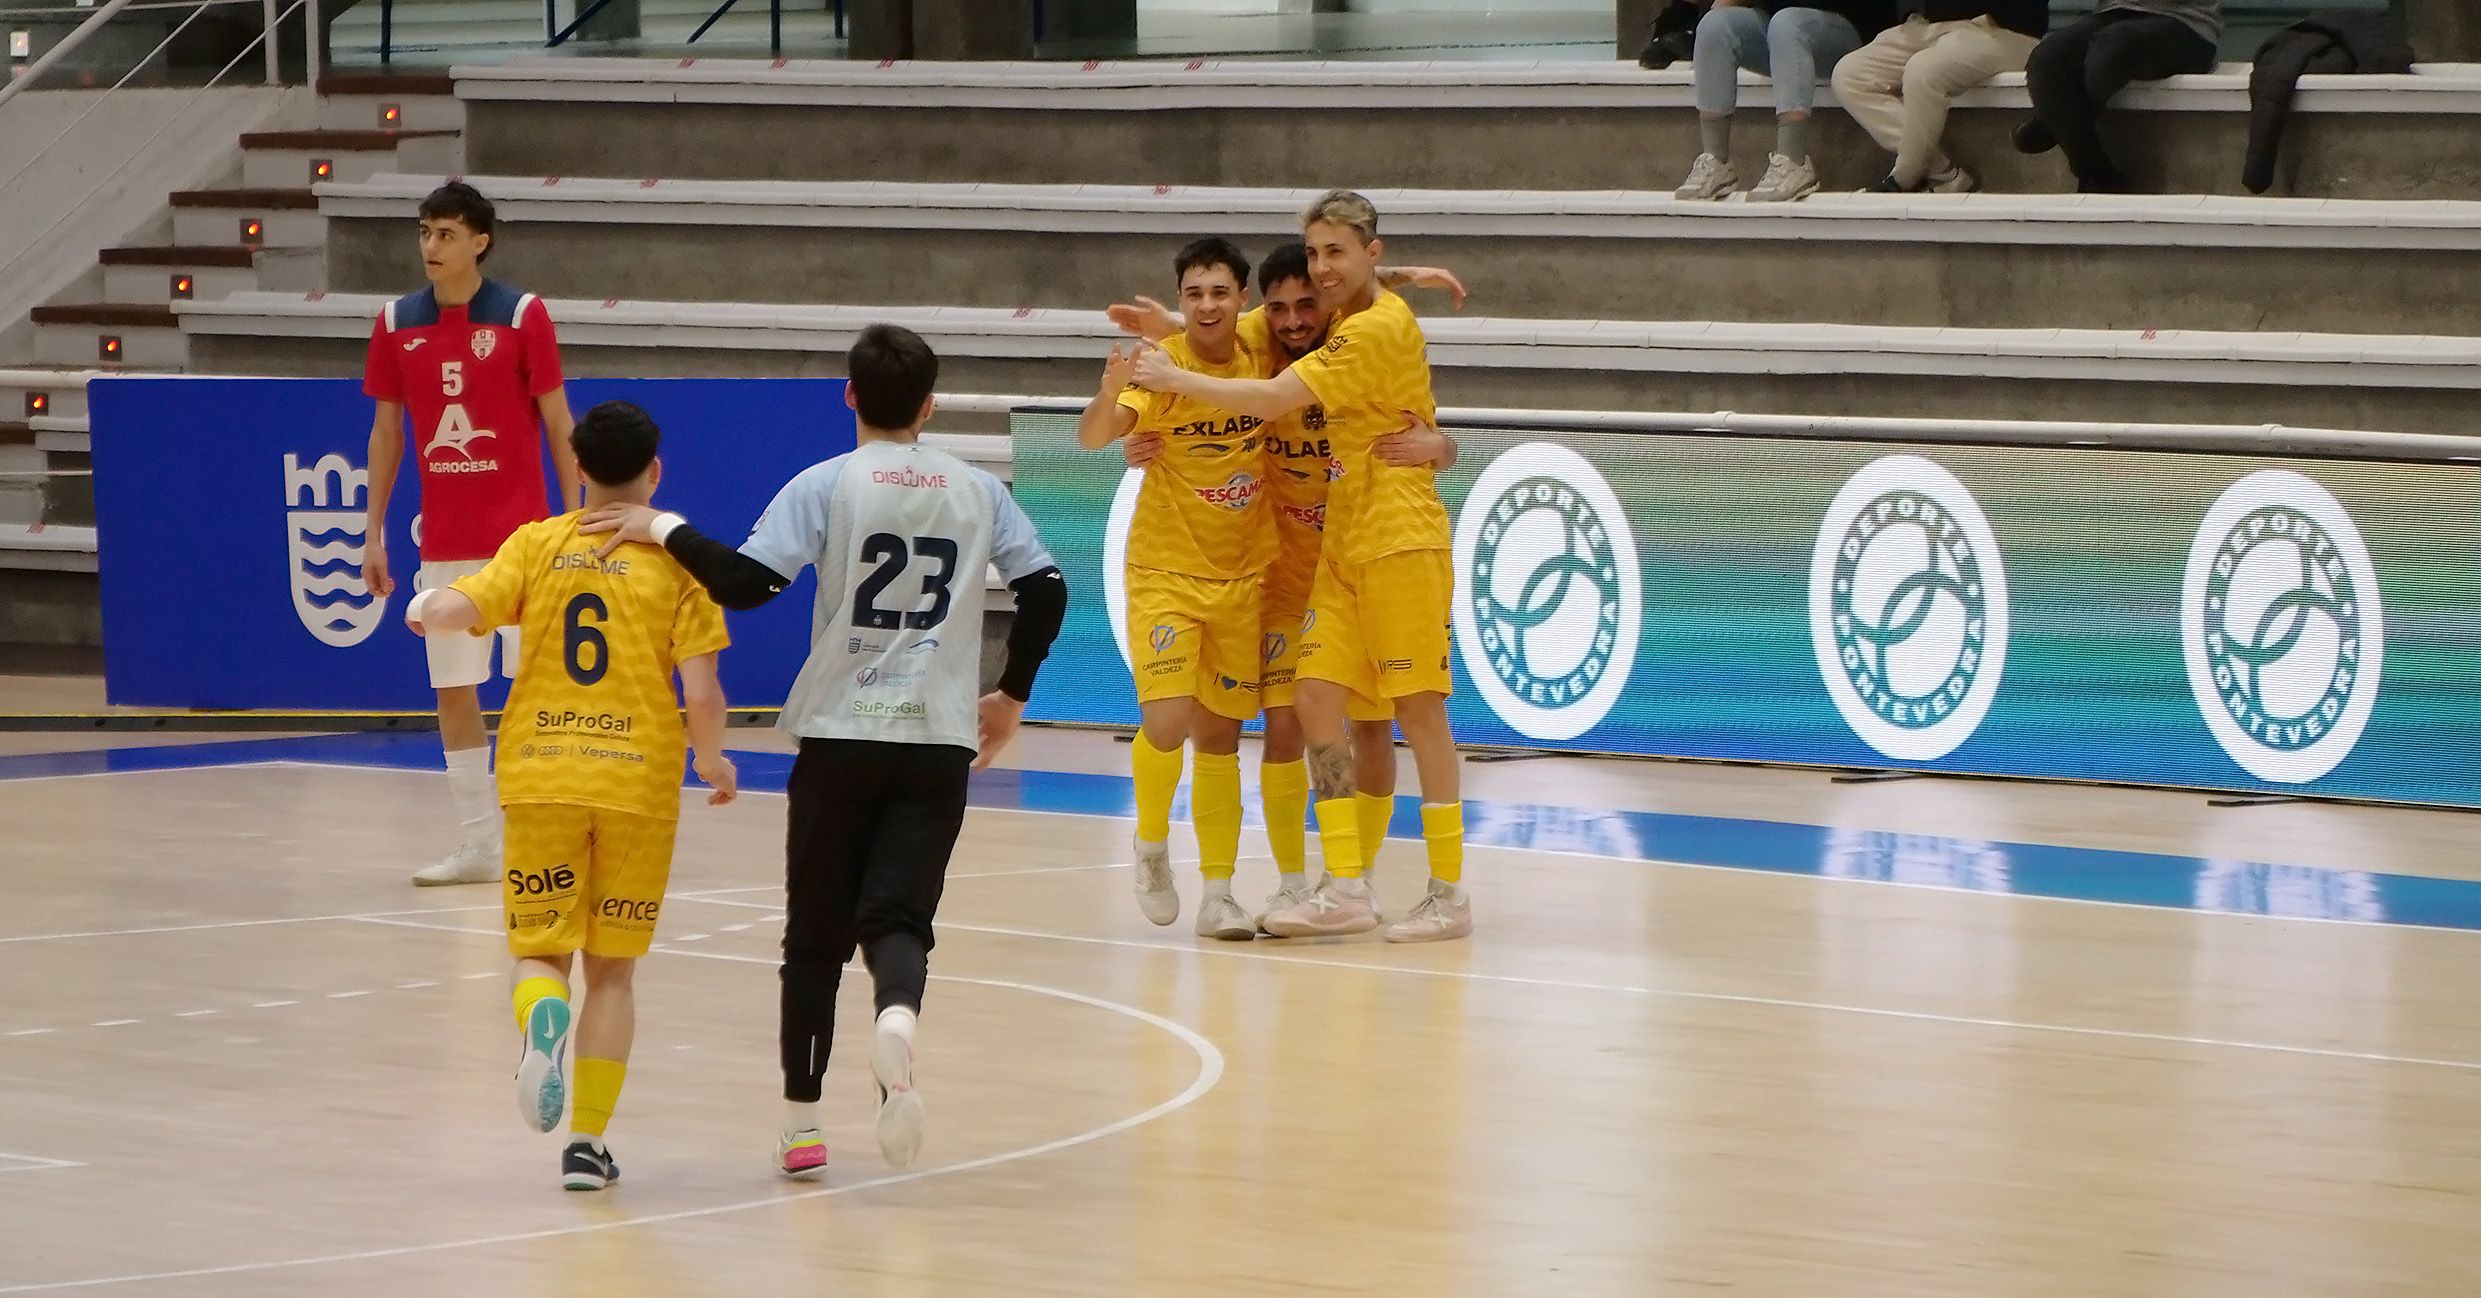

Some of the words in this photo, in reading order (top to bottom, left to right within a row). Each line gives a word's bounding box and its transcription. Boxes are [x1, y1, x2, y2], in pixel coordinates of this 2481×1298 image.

[441, 361, 463, 396] 5
[429, 460, 498, 473] AGROCESA
[872, 470, 948, 488] DISLUME
[1484, 483, 1603, 546] DEPORTE
[1845, 499, 1970, 562] DEPORTE
[2216, 513, 2343, 581] DEPORTE
[851, 532, 958, 630] 23
[564, 592, 608, 686] 6
[1476, 598, 1617, 702] PONTEVEDRA
[1836, 614, 1981, 722] PONTEVEDRA
[853, 700, 926, 714] SuProGal
[2208, 633, 2357, 743] PONTEVEDRA
[536, 711, 631, 732] SuProGal
[579, 746, 644, 762] Vepersa
